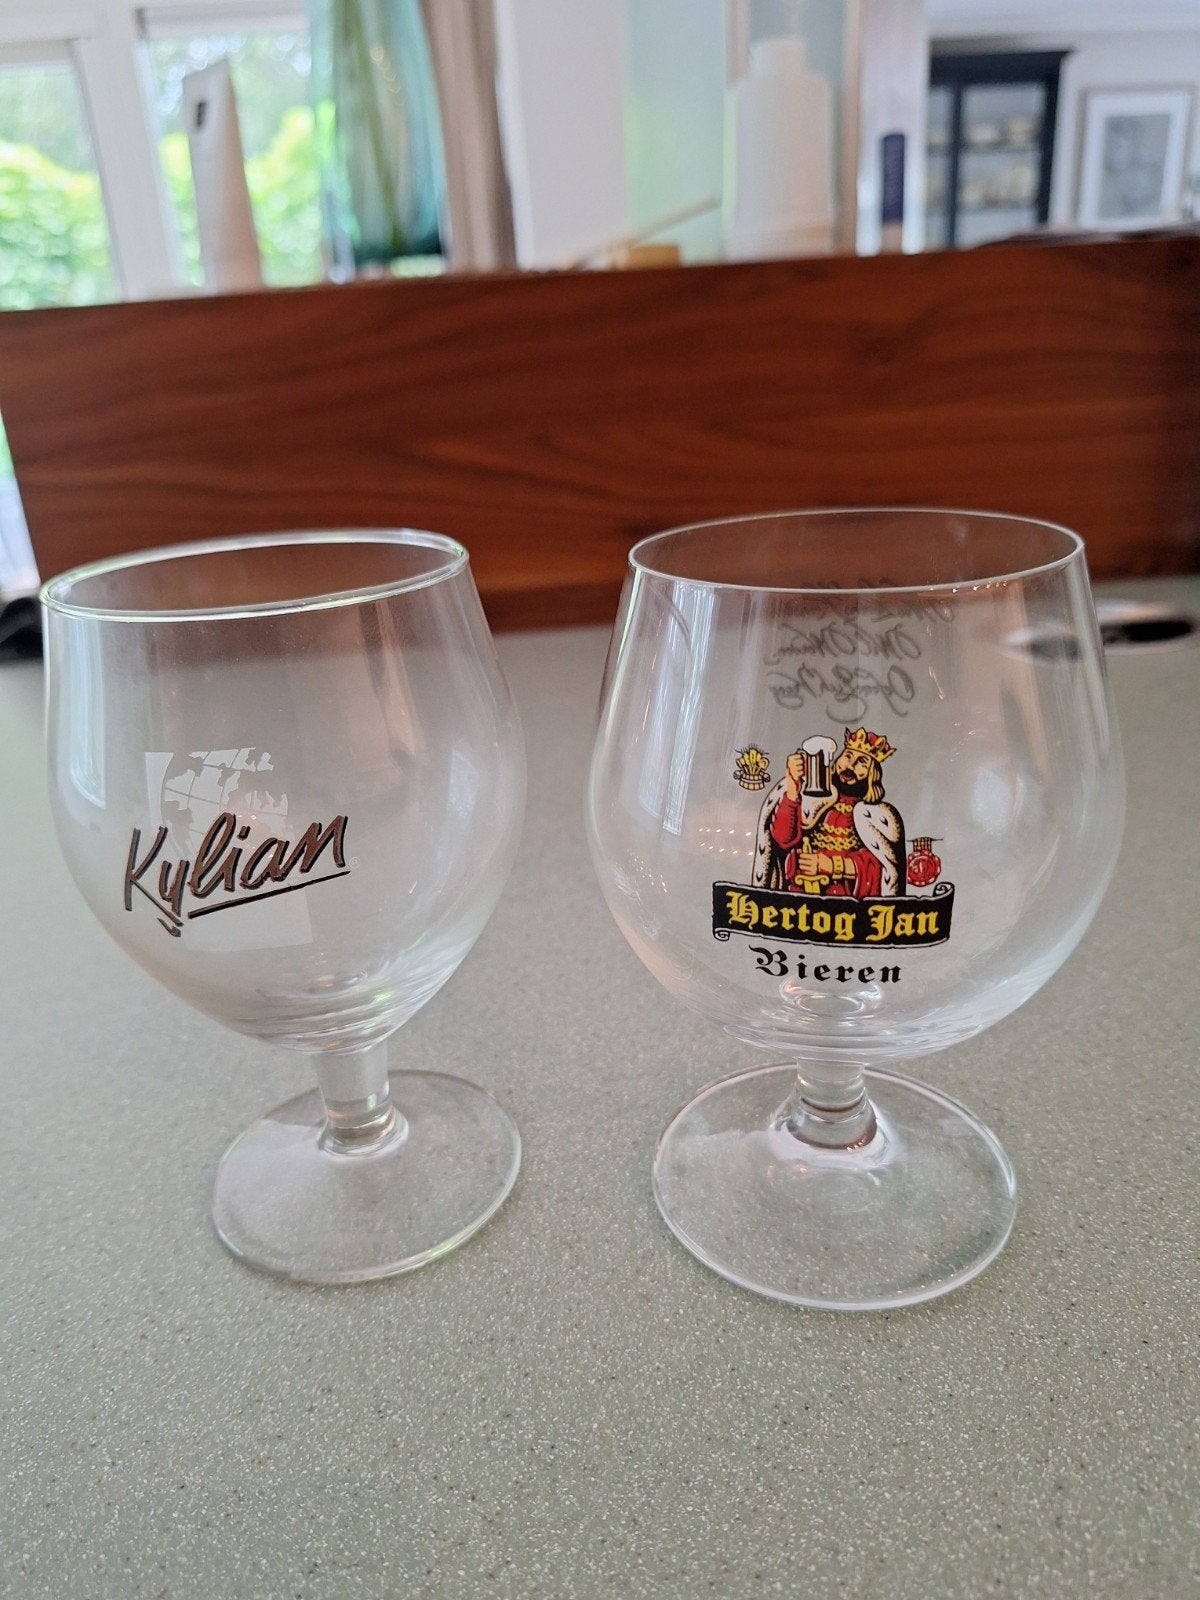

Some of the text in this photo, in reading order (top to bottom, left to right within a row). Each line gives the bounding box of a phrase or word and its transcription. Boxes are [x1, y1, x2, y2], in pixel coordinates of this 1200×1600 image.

[124, 812, 348, 937] Kylian
[726, 891, 939, 941] Hertog Jan
[749, 944, 902, 983] Bieren
